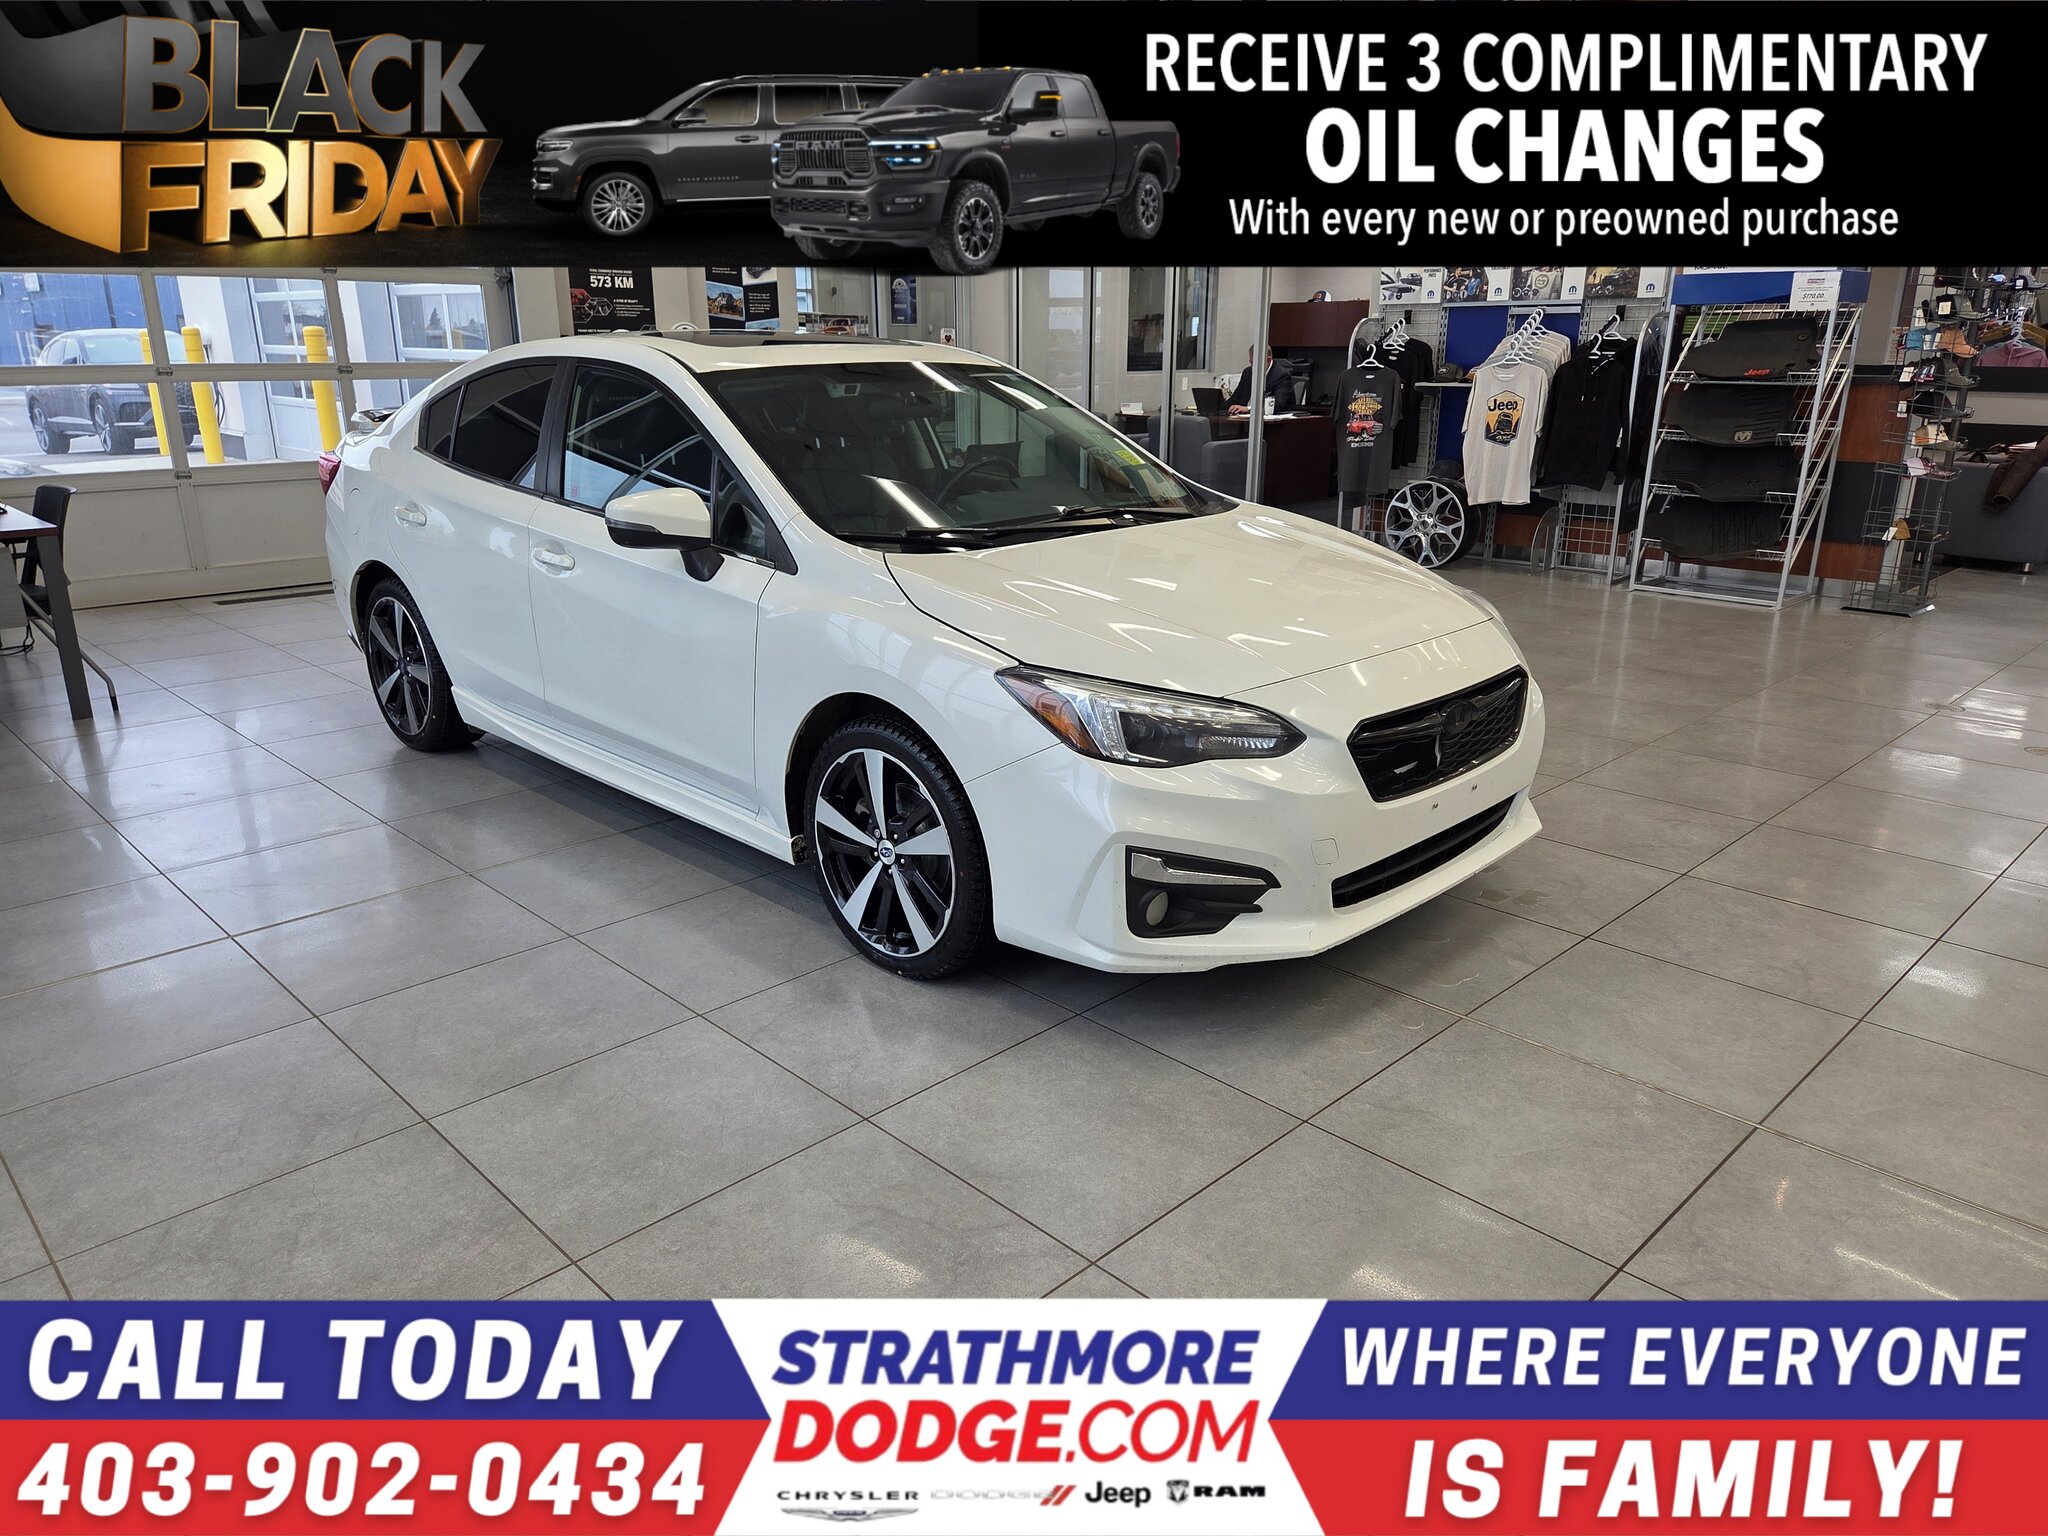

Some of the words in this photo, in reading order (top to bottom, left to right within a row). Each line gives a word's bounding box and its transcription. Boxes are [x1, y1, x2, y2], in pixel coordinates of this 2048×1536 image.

[590, 275, 612, 288] 573
[615, 276, 634, 289] KM
[1488, 399, 1518, 412] Jeep
